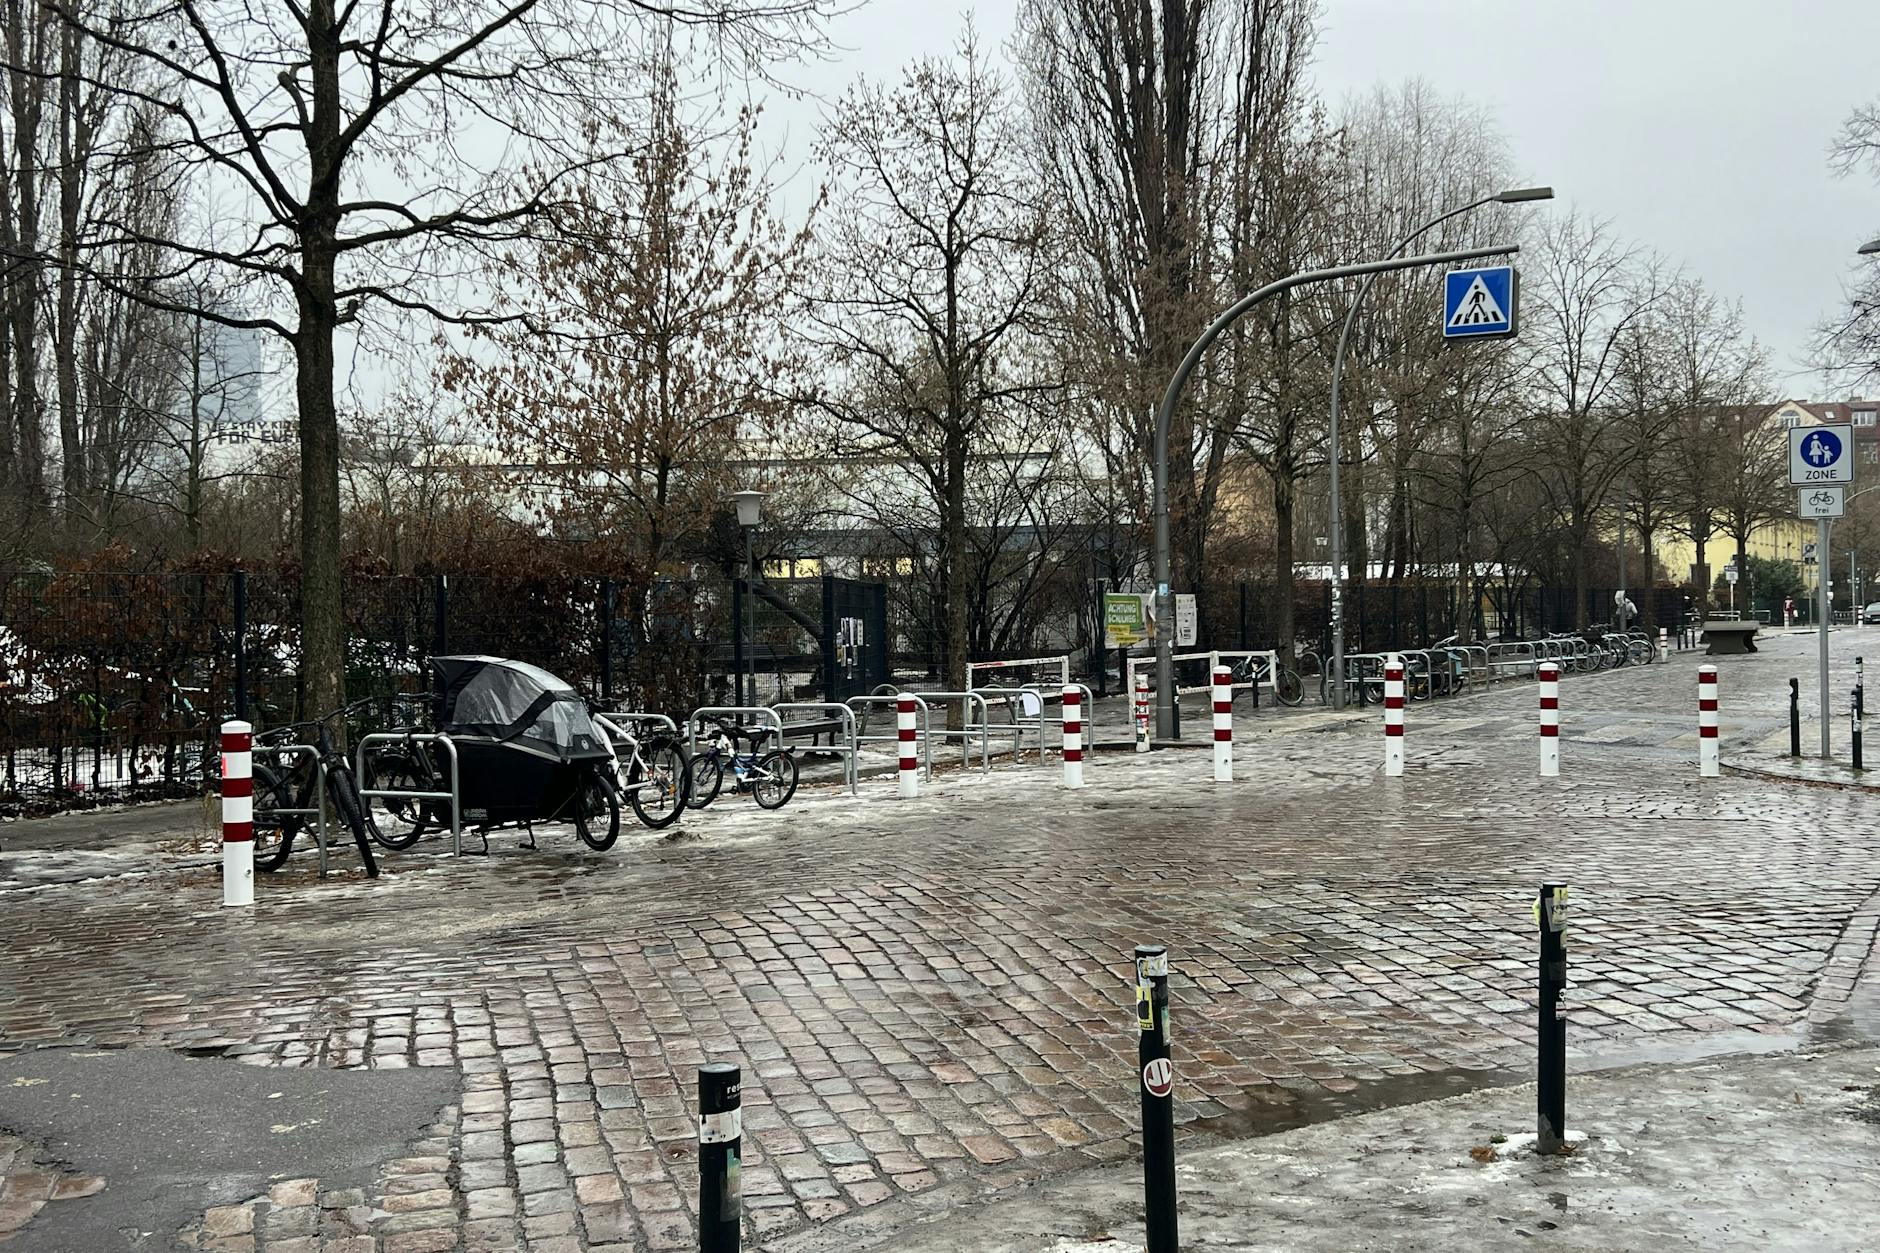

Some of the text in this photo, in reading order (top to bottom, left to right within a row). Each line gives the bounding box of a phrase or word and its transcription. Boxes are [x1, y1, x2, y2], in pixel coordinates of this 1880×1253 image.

[218, 431, 250, 445] FOR
[1805, 469, 1837, 480] ZONE
[1108, 603, 1137, 613] ACHTUNG
[1108, 614, 1137, 624] SCHULWEG
